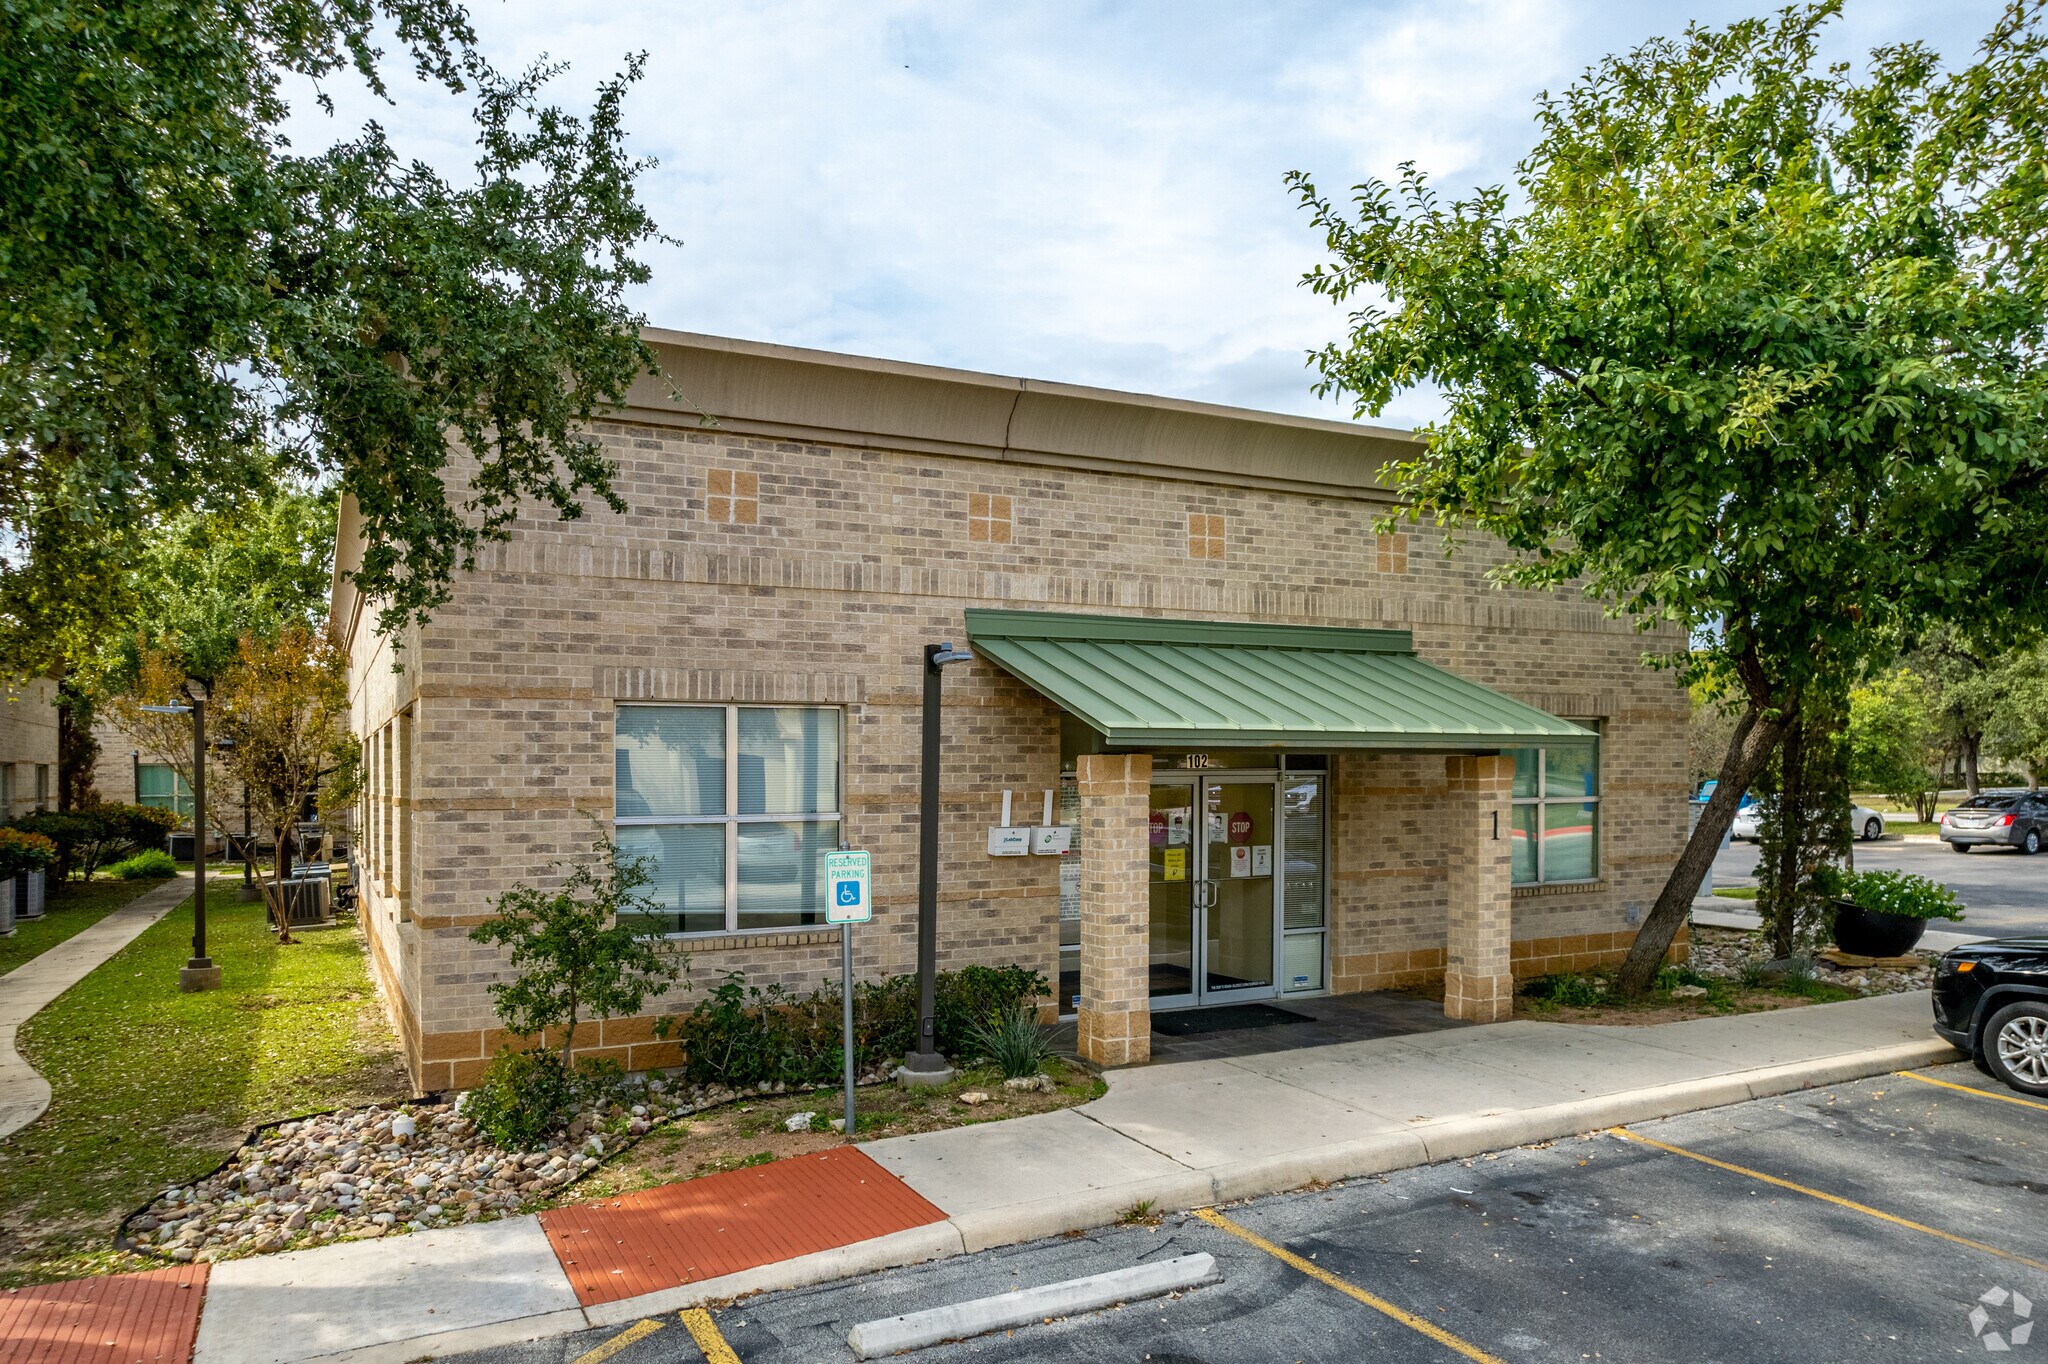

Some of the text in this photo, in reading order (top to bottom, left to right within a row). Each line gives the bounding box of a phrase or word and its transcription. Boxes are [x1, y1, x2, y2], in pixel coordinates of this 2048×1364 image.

[1188, 754, 1208, 768] 102
[1149, 822, 1164, 834] TOP
[1232, 822, 1250, 833] STOP
[1490, 810, 1500, 840] 1
[829, 858, 866, 867] RESERVED
[831, 870, 864, 878] PARKING
